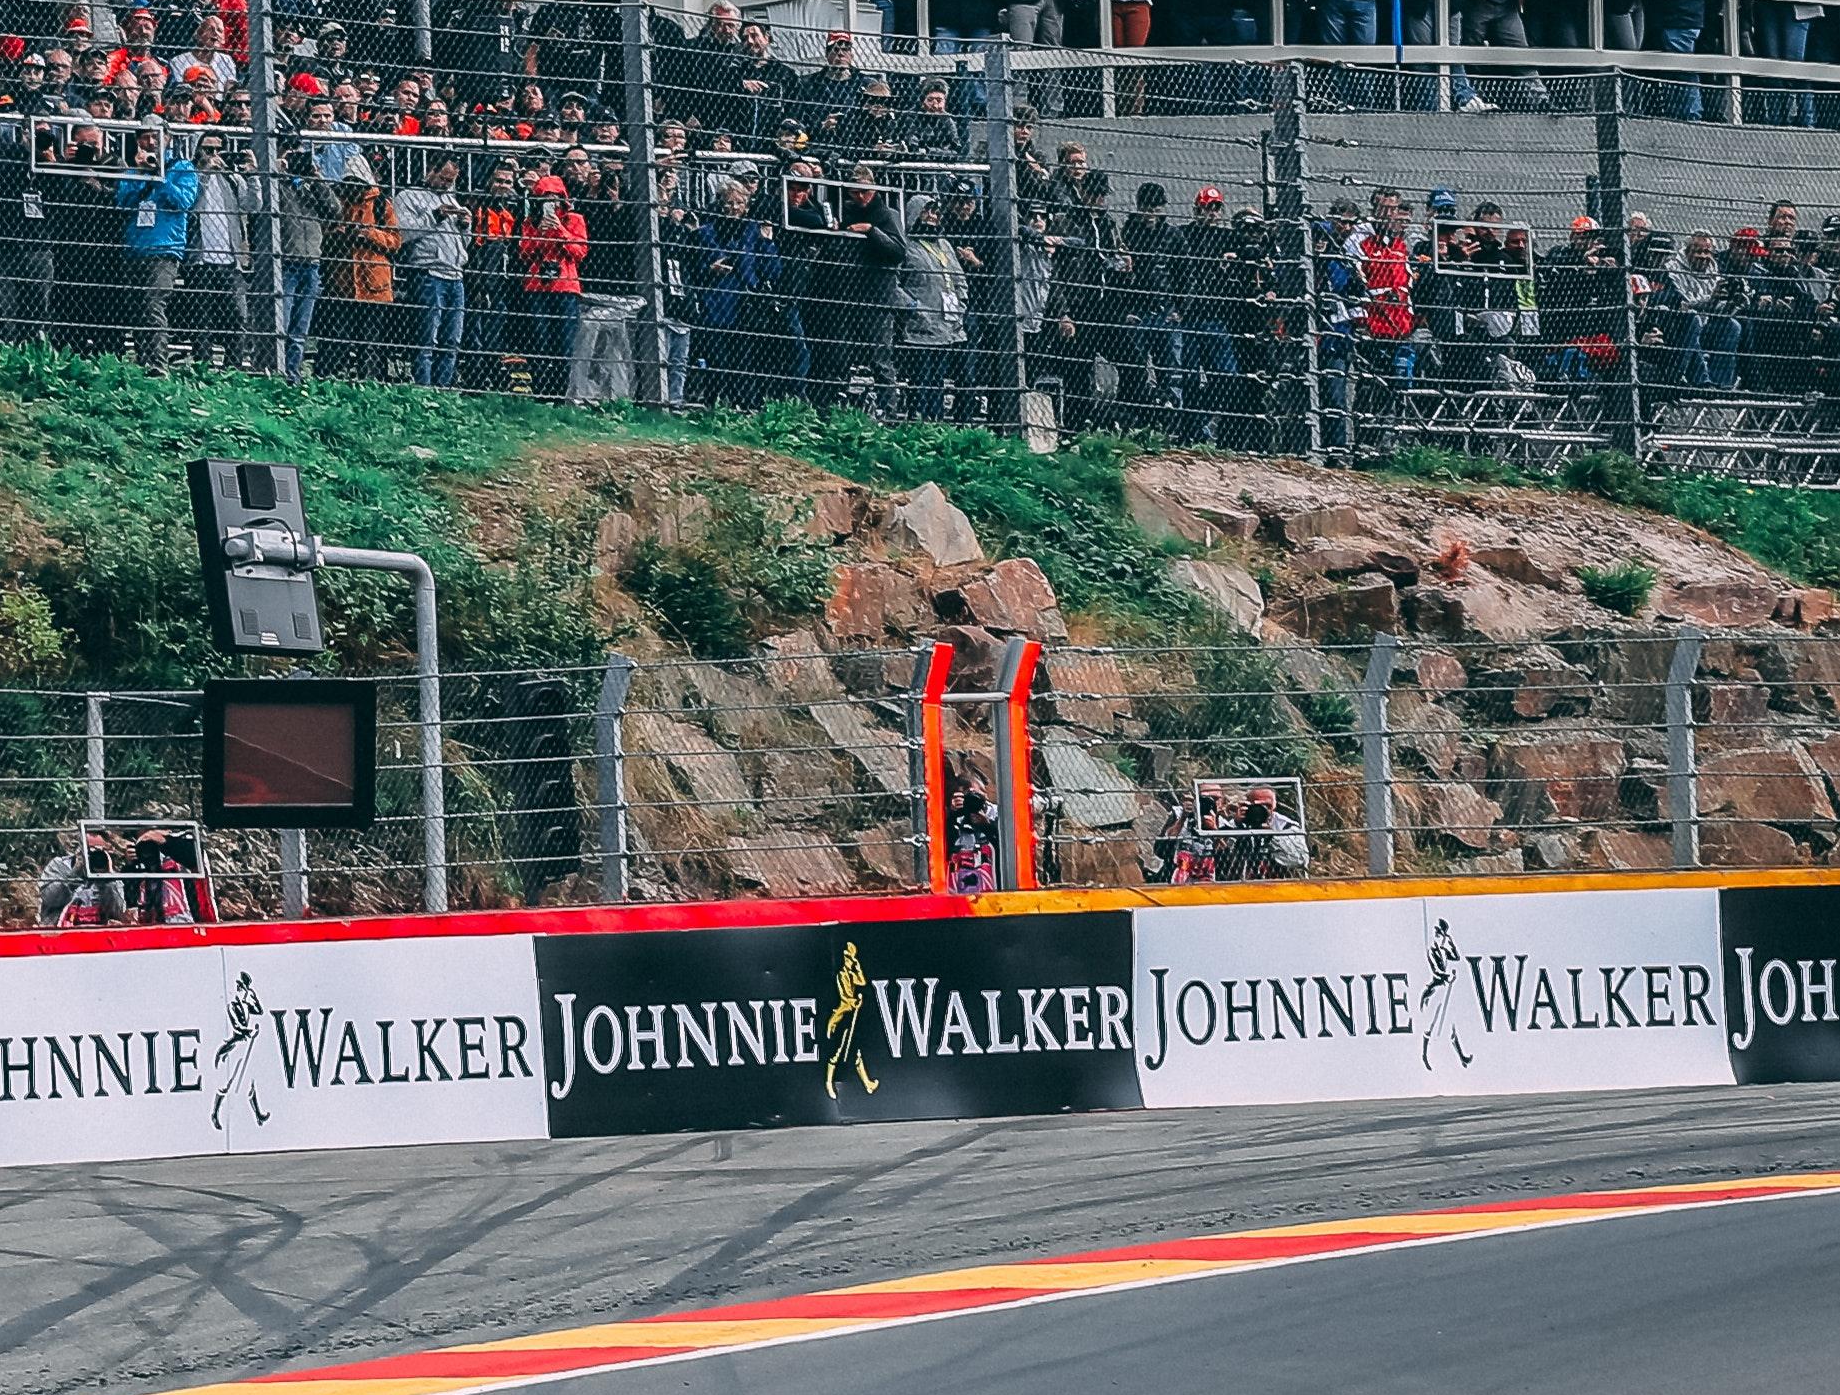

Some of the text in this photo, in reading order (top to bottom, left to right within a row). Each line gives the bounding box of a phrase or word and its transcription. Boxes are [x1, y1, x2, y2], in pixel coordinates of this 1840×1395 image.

[270, 1008, 533, 1088] WALKER
[551, 977, 1132, 1099] JOHNNIE WALKER
[1145, 955, 1717, 1070] JOHNNIE WALKER
